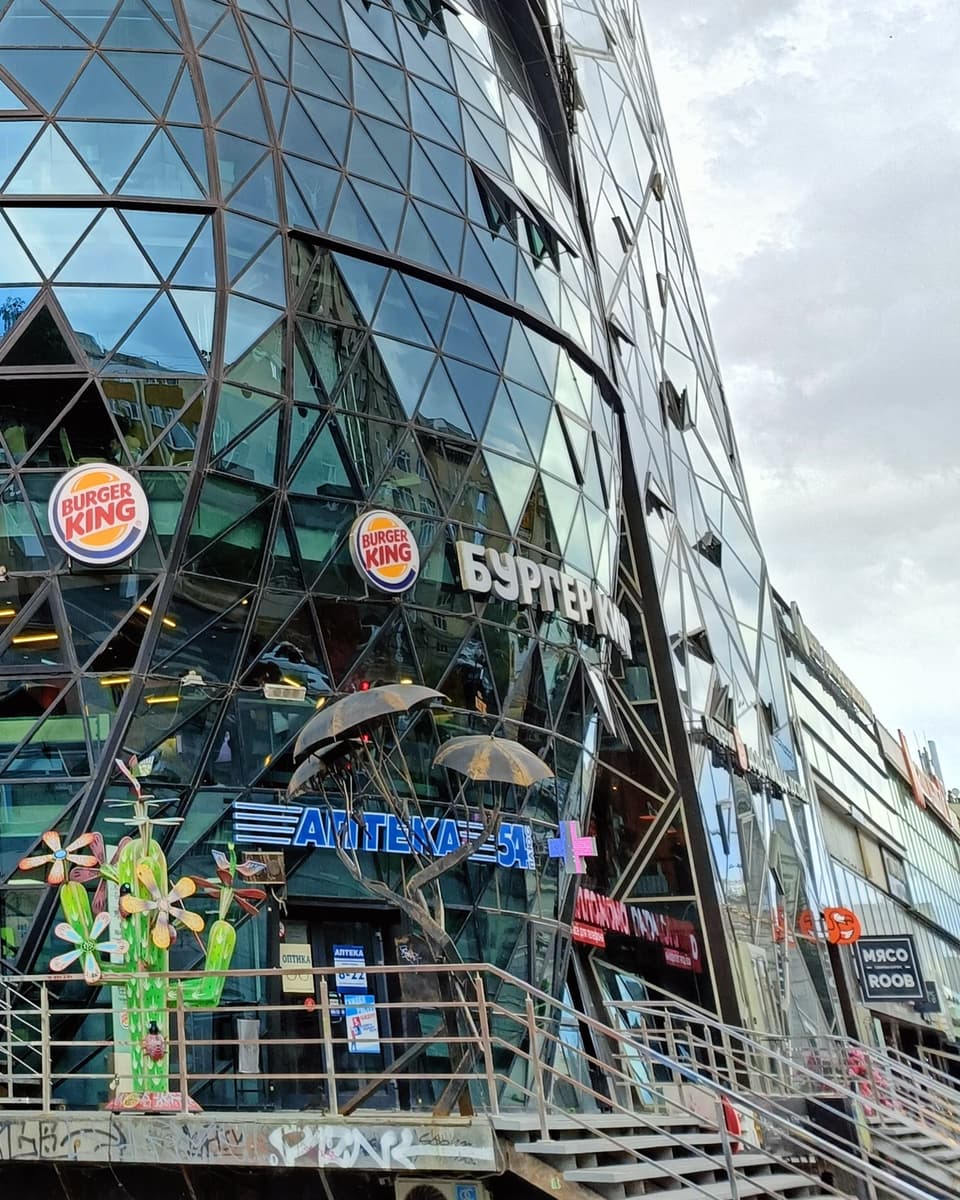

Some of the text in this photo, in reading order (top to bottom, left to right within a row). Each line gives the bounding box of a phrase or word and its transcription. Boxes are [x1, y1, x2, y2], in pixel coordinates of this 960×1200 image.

[61, 483, 134, 517] BURGER
[63, 498, 137, 542] KING
[361, 527, 409, 551] BURGER
[364, 542, 412, 570] KING
[456, 540, 594, 626] БУРГЕР
[292, 806, 529, 868] АПТЕКА 54
[282, 954, 311, 964] ОПТИКА
[334, 948, 364, 957] АПТЕКА
[862, 948, 909, 963] МЯСО
[868, 973, 915, 988] ROOB
